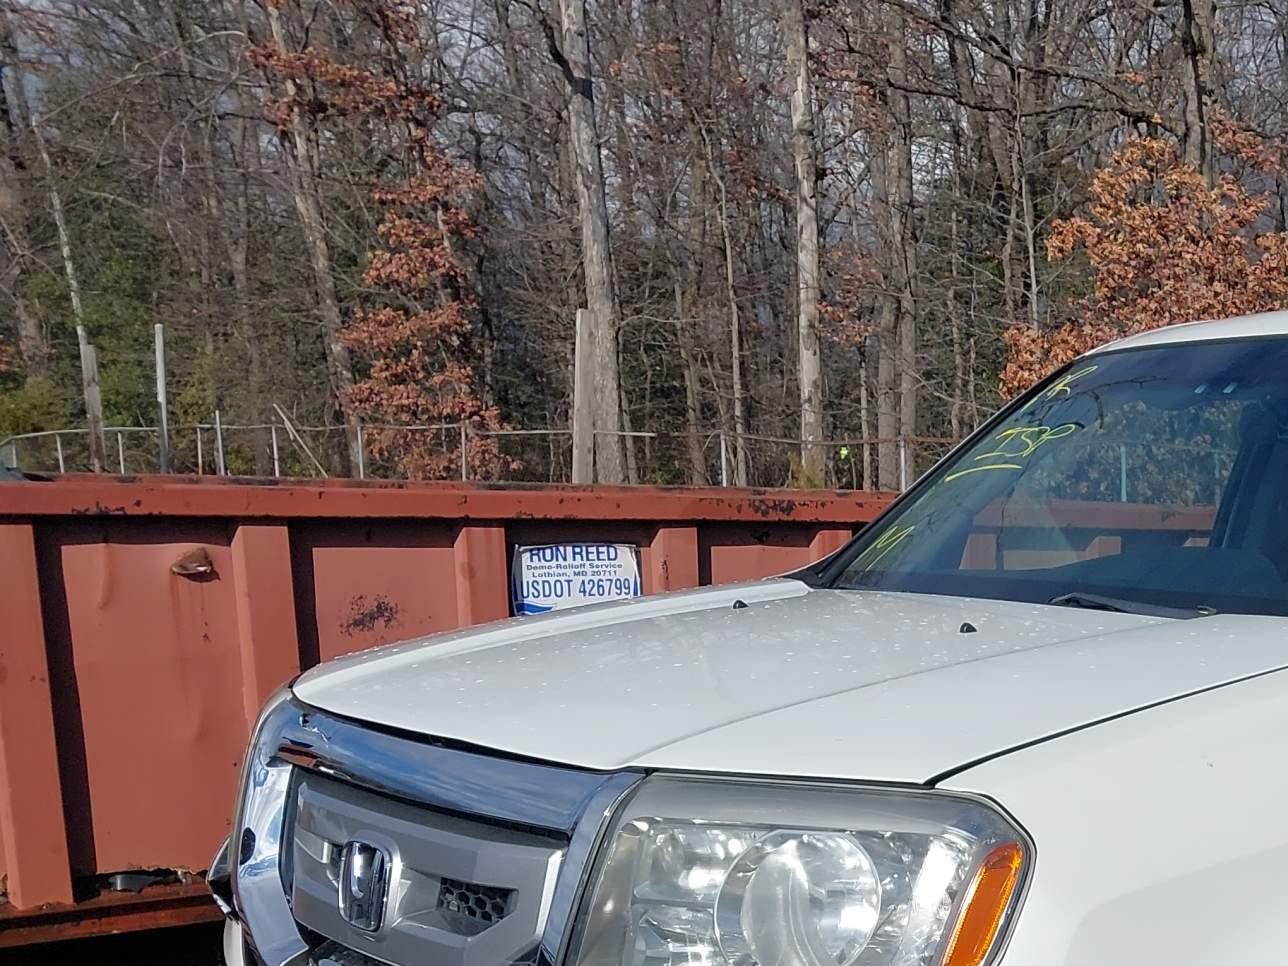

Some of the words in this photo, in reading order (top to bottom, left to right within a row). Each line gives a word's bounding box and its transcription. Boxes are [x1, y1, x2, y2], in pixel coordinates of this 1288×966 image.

[571, 544, 618, 562] REED
[588, 562, 623, 570] Service
[590, 569, 617, 577] 20711
[521, 579, 573, 599] USDOT
[578, 577, 631, 597] 426799
